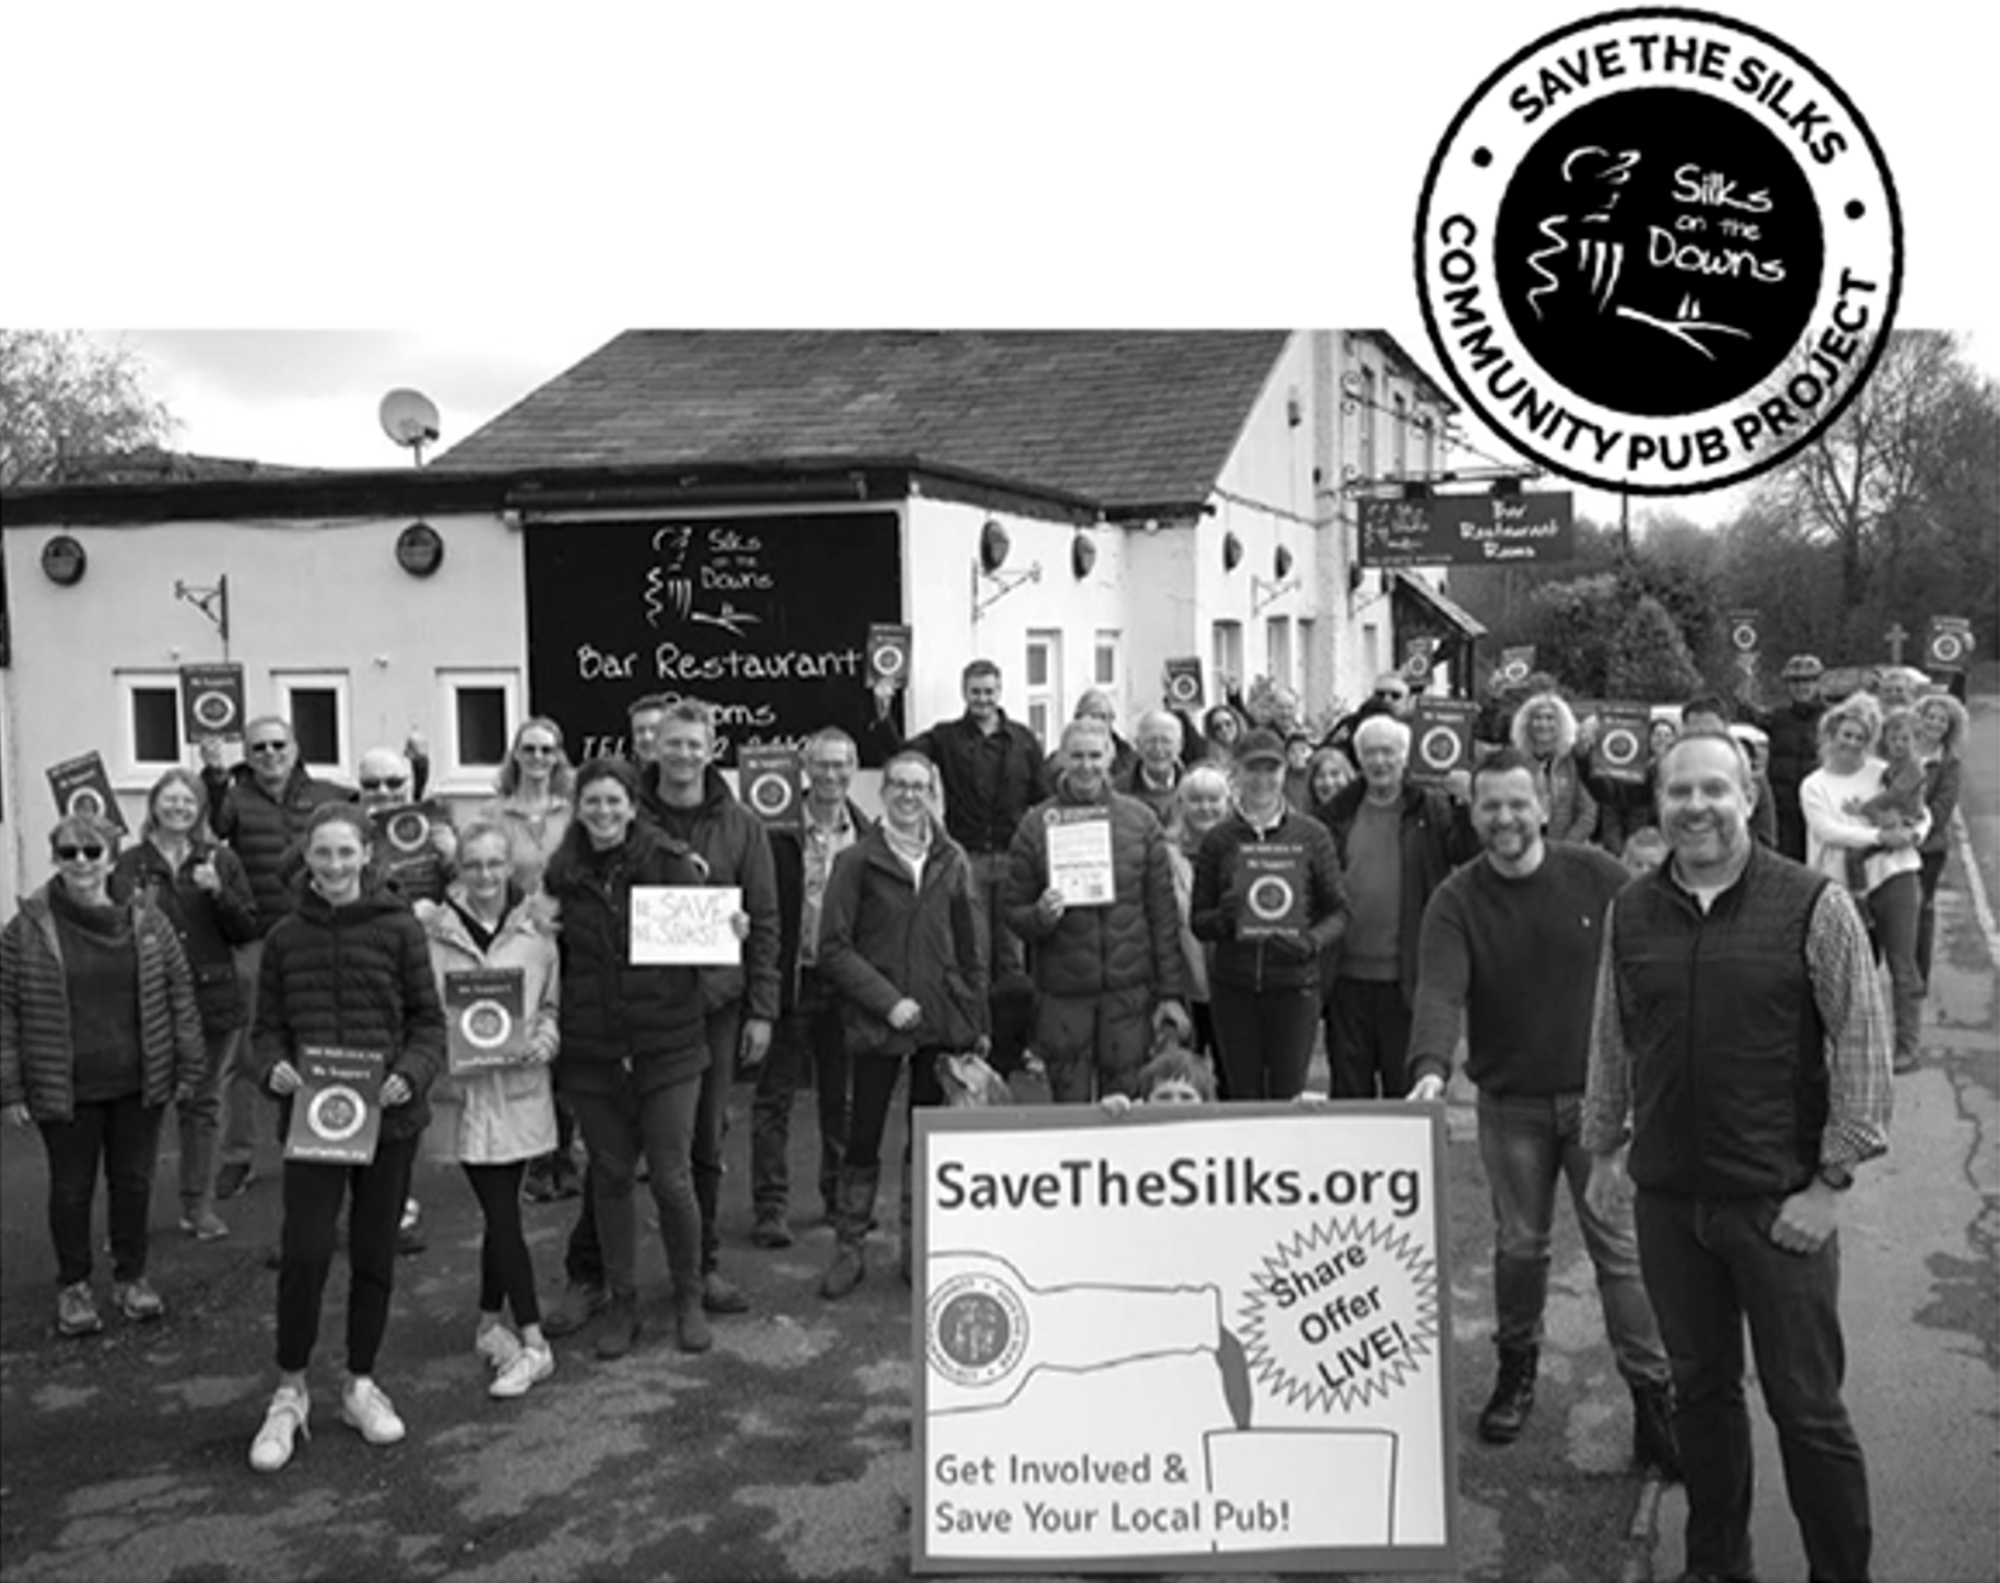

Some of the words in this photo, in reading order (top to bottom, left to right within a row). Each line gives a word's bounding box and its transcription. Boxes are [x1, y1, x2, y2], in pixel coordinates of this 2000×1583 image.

[701, 565, 774, 589] Downs
[577, 644, 637, 679] Bar
[656, 642, 864, 679] Restaurant
[936, 1158, 1421, 1217] SaveTheSilks.org
[1271, 1243, 1368, 1309] Share
[1300, 1282, 1382, 1346] Offer
[1316, 1321, 1410, 1390] LIVE!
[936, 1454, 995, 1486] Get
[1010, 1453, 1152, 1484] Involved
[1163, 1453, 1189, 1484] &
[936, 1502, 1013, 1533] Save
[1024, 1502, 1099, 1532] Your
[1112, 1501, 1201, 1532] Local
[1215, 1500, 1291, 1533] Pub!
